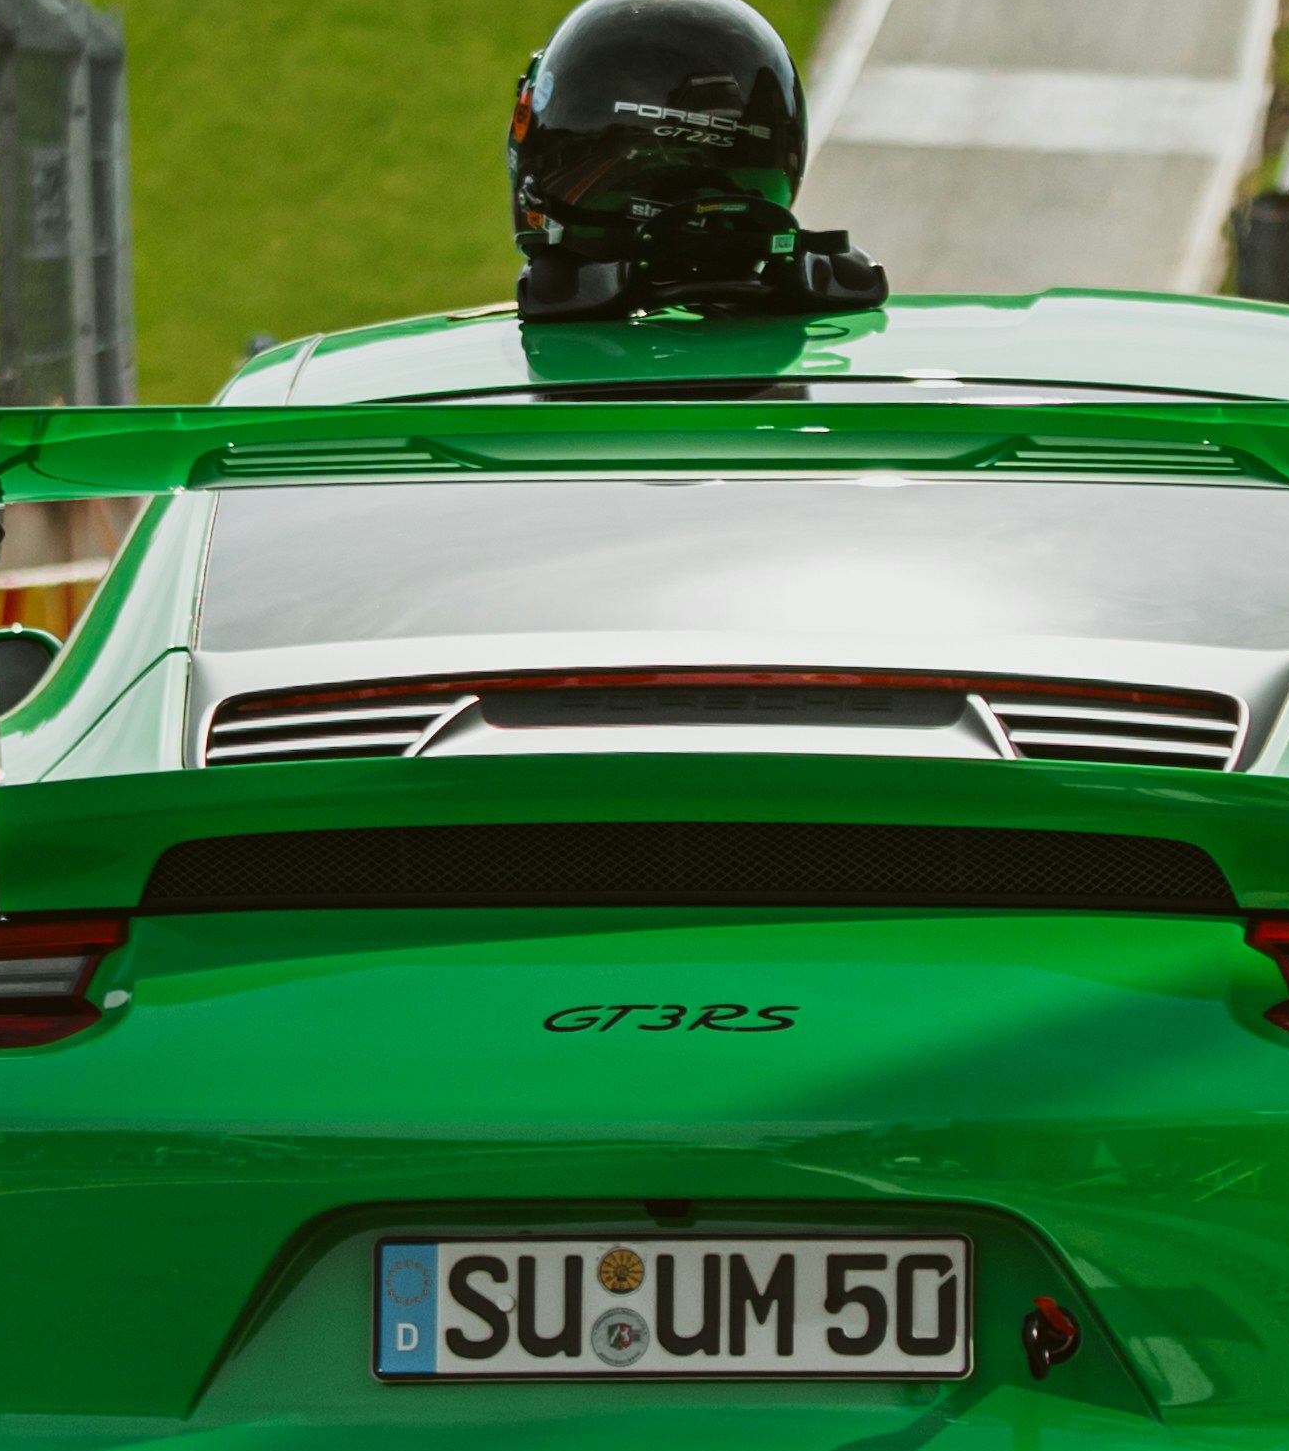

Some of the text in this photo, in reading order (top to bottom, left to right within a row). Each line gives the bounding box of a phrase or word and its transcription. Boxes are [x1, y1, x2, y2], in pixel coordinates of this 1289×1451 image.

[614, 101, 771, 139] PORSCHE
[446, 1254, 583, 1359] SU
[656, 1253, 795, 1357] UM
[824, 1253, 957, 1357] 50
[396, 1323, 419, 1352] D
